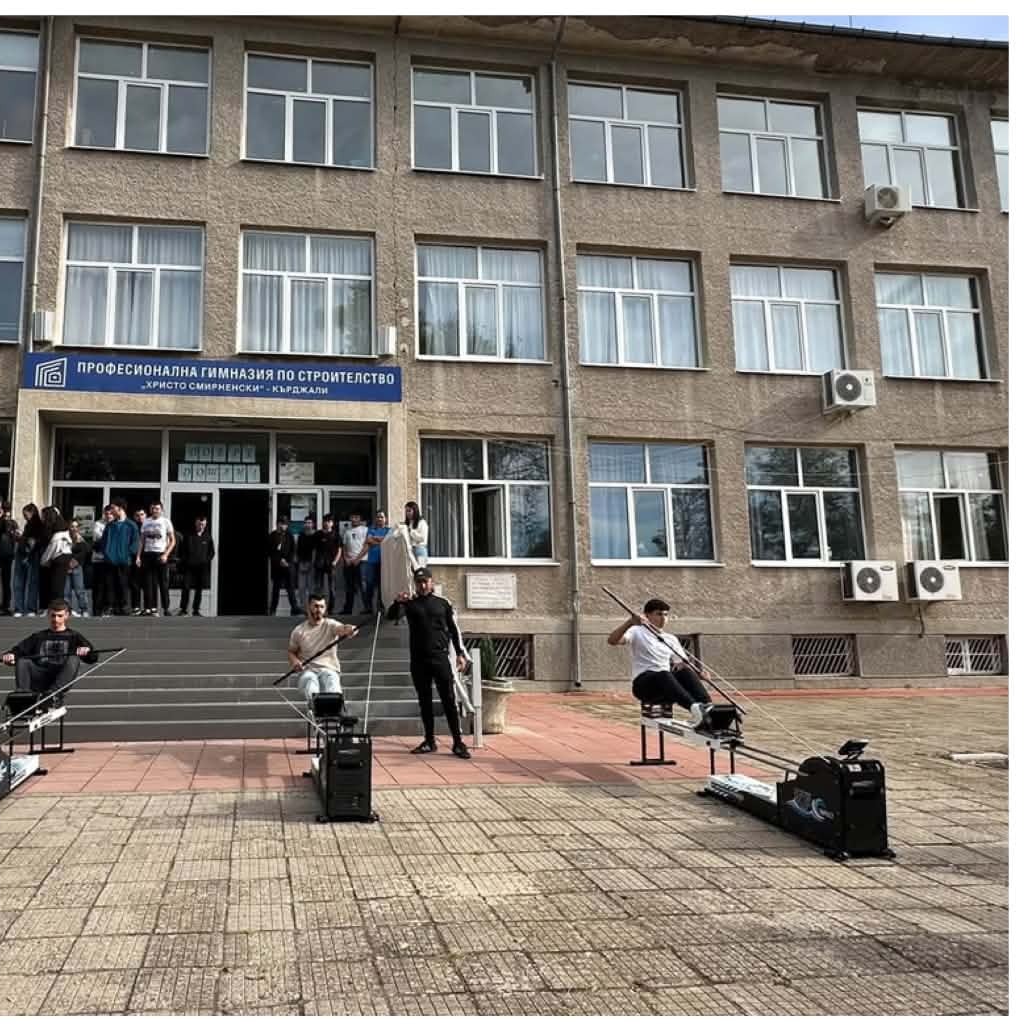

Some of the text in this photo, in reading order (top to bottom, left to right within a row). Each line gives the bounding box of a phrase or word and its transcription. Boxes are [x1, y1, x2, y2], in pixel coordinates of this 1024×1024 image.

[76, 361, 395, 385] ПРОФЕСИОНАЛНА ГИМНАЗИЯ ПО СТРОИТЕЛСТВО
[272, 385, 328, 395] КЪРДЖАЛИ
